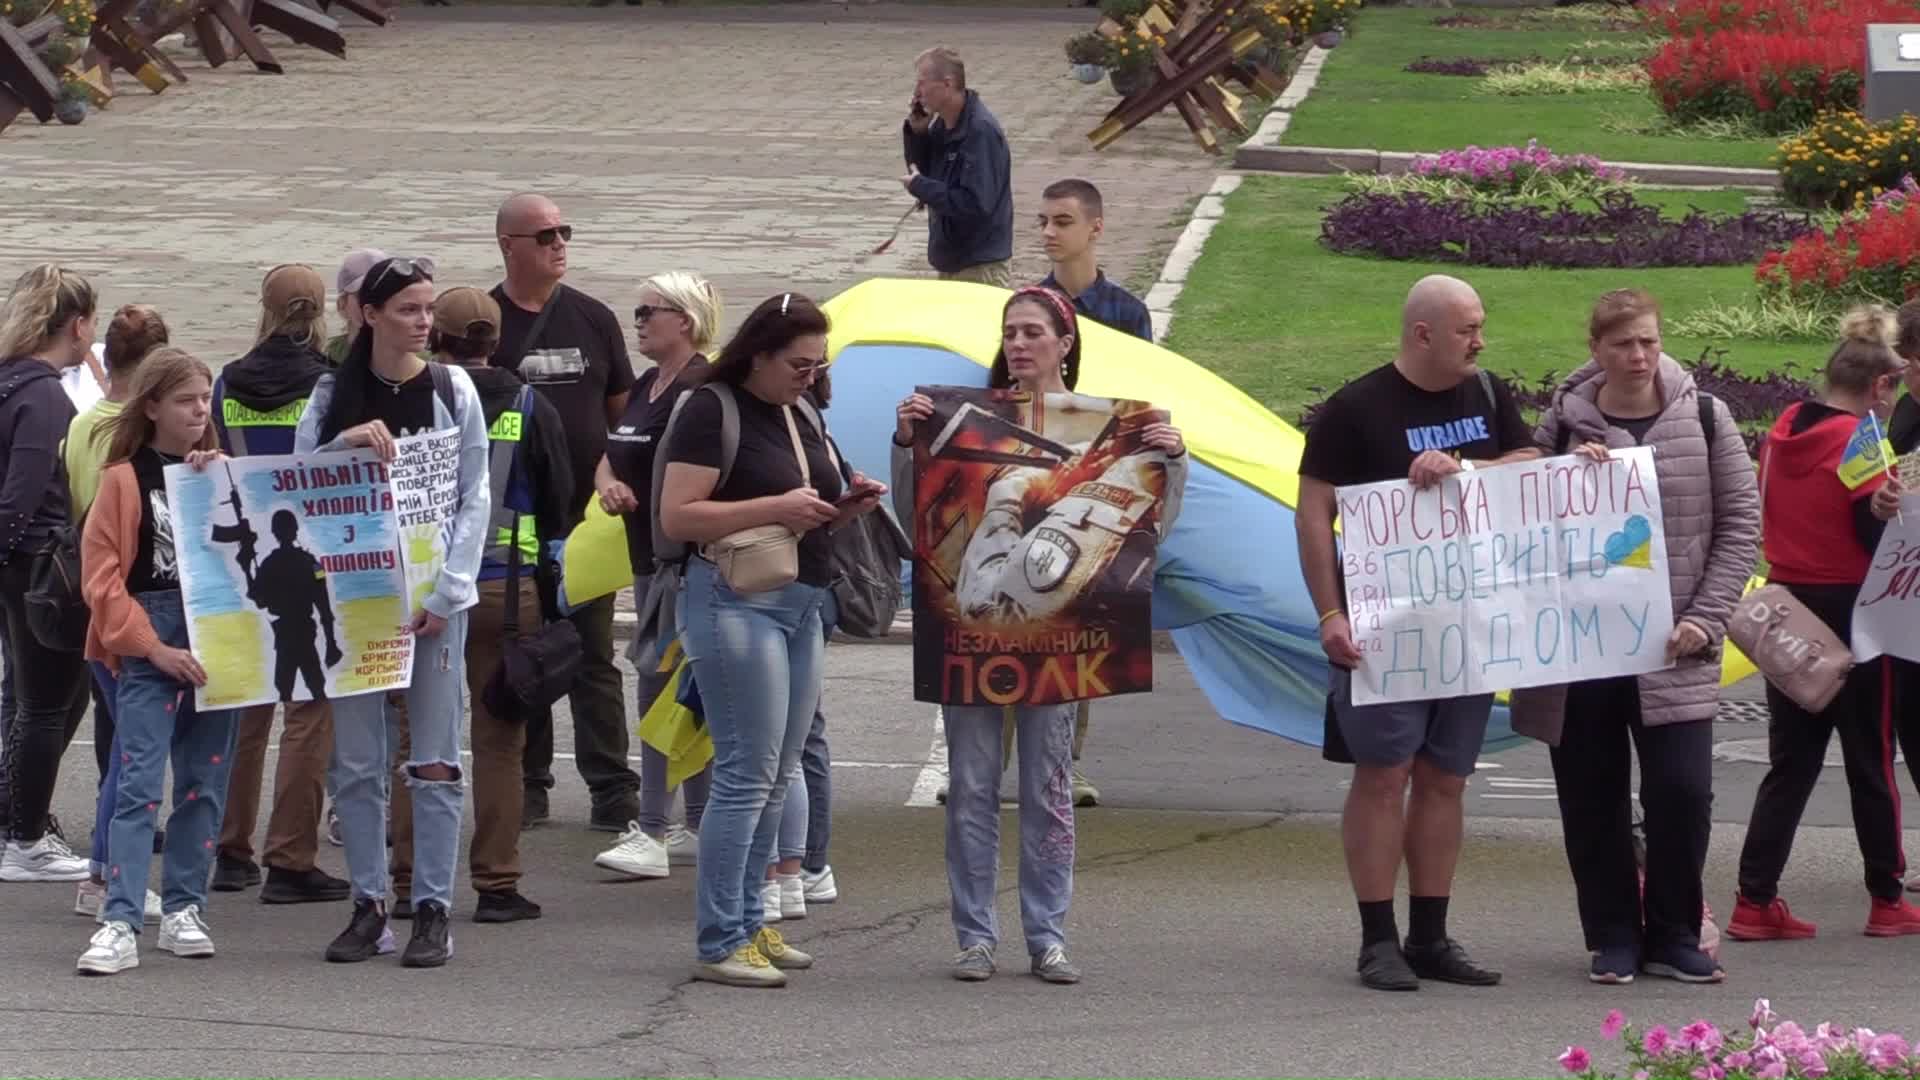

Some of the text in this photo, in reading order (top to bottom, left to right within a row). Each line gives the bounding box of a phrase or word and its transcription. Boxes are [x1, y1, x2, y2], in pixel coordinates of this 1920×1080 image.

[1406, 416, 1490, 452] UKRAINE
[271, 456, 390, 492] ЗВІЛЬНІТЬ
[392, 452, 430, 468] СОНЦЕ
[302, 488, 393, 517] ХЛОПЦІВ
[397, 493, 422, 512] МІЙ
[1340, 457, 1650, 551] МОРСЬКА ПІХОТА
[343, 524, 355, 544] З
[319, 550, 396, 573] ПОЛОНУ
[1343, 551, 1378, 577] 36
[1384, 526, 1608, 609] ПОВЕРНІТЬ
[943, 626, 1109, 654] НЕЗЛАМНИЙ
[942, 650, 1112, 704] ПОЛК
